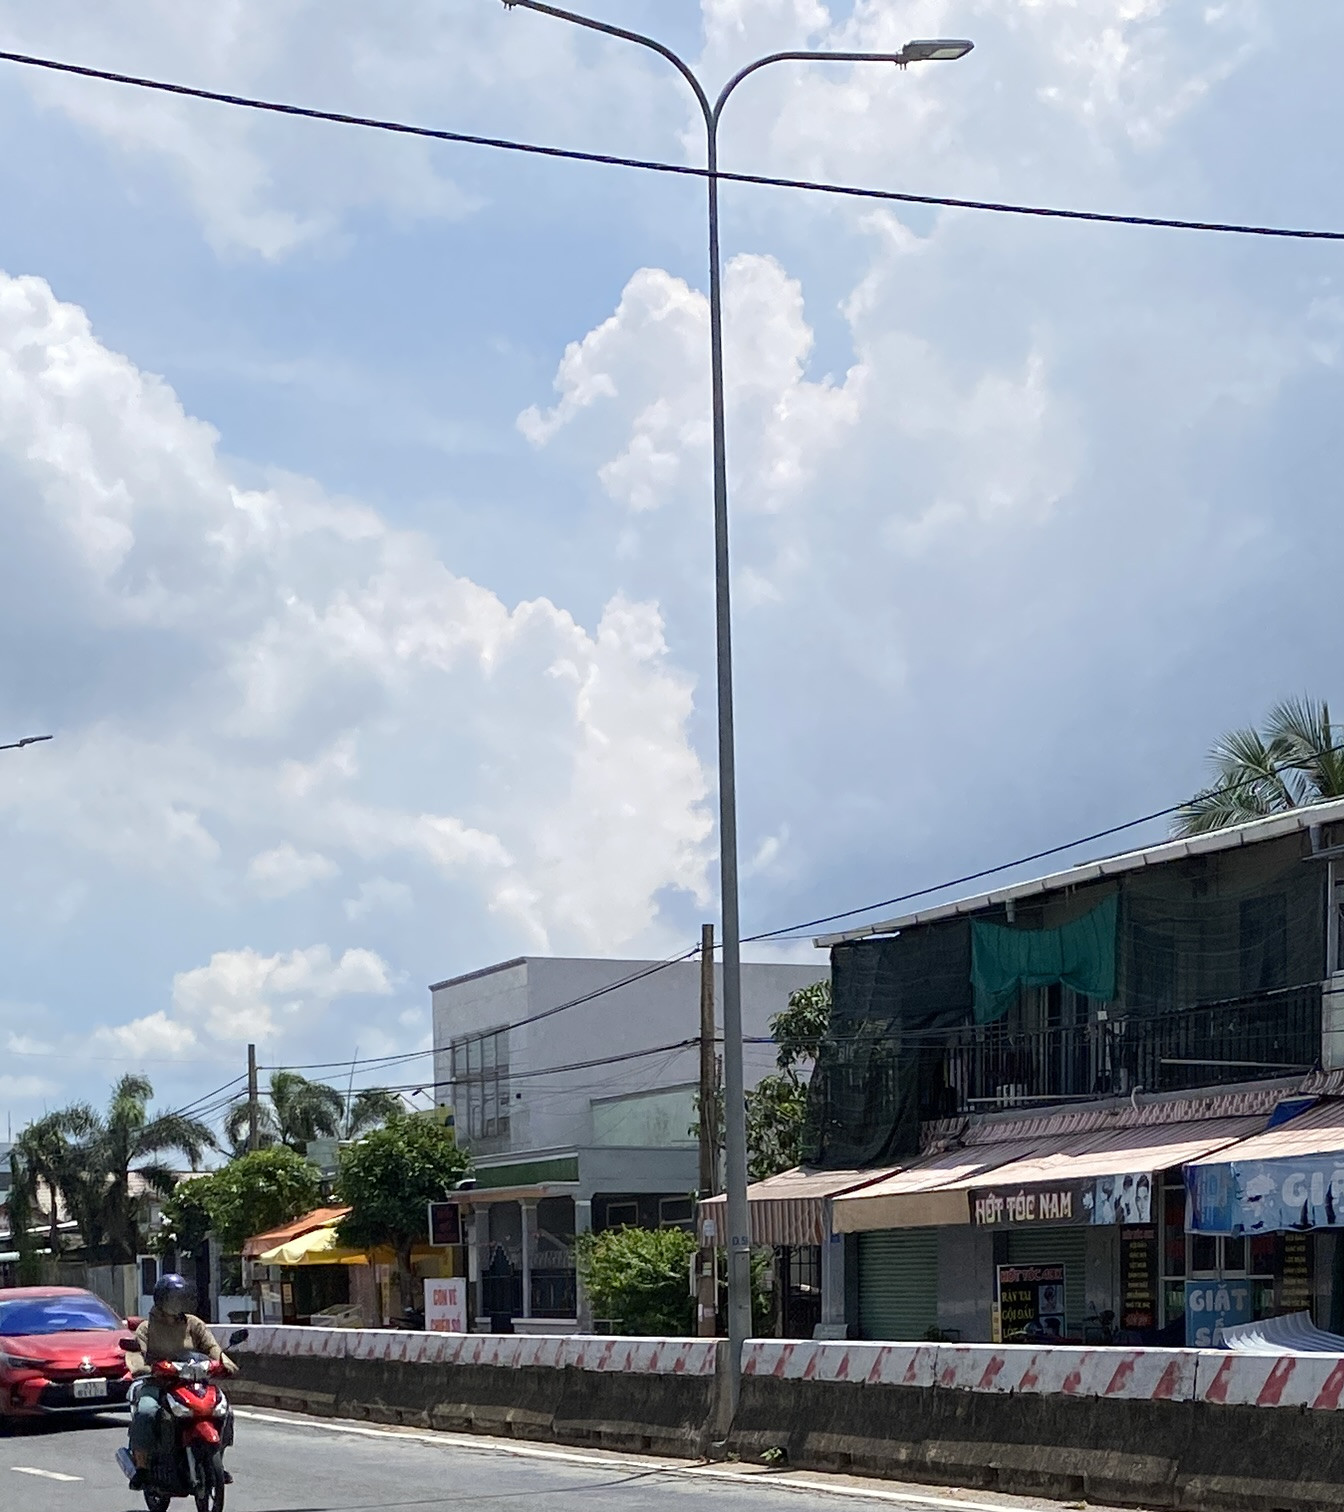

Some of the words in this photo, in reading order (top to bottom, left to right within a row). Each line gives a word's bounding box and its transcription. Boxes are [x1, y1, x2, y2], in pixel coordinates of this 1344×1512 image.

[975, 1191, 1004, 1227] HỚT
[1006, 1189, 1036, 1221] TÓC
[1039, 1191, 1072, 1219] NAM
[1189, 1284, 1248, 1316] GIẶT
